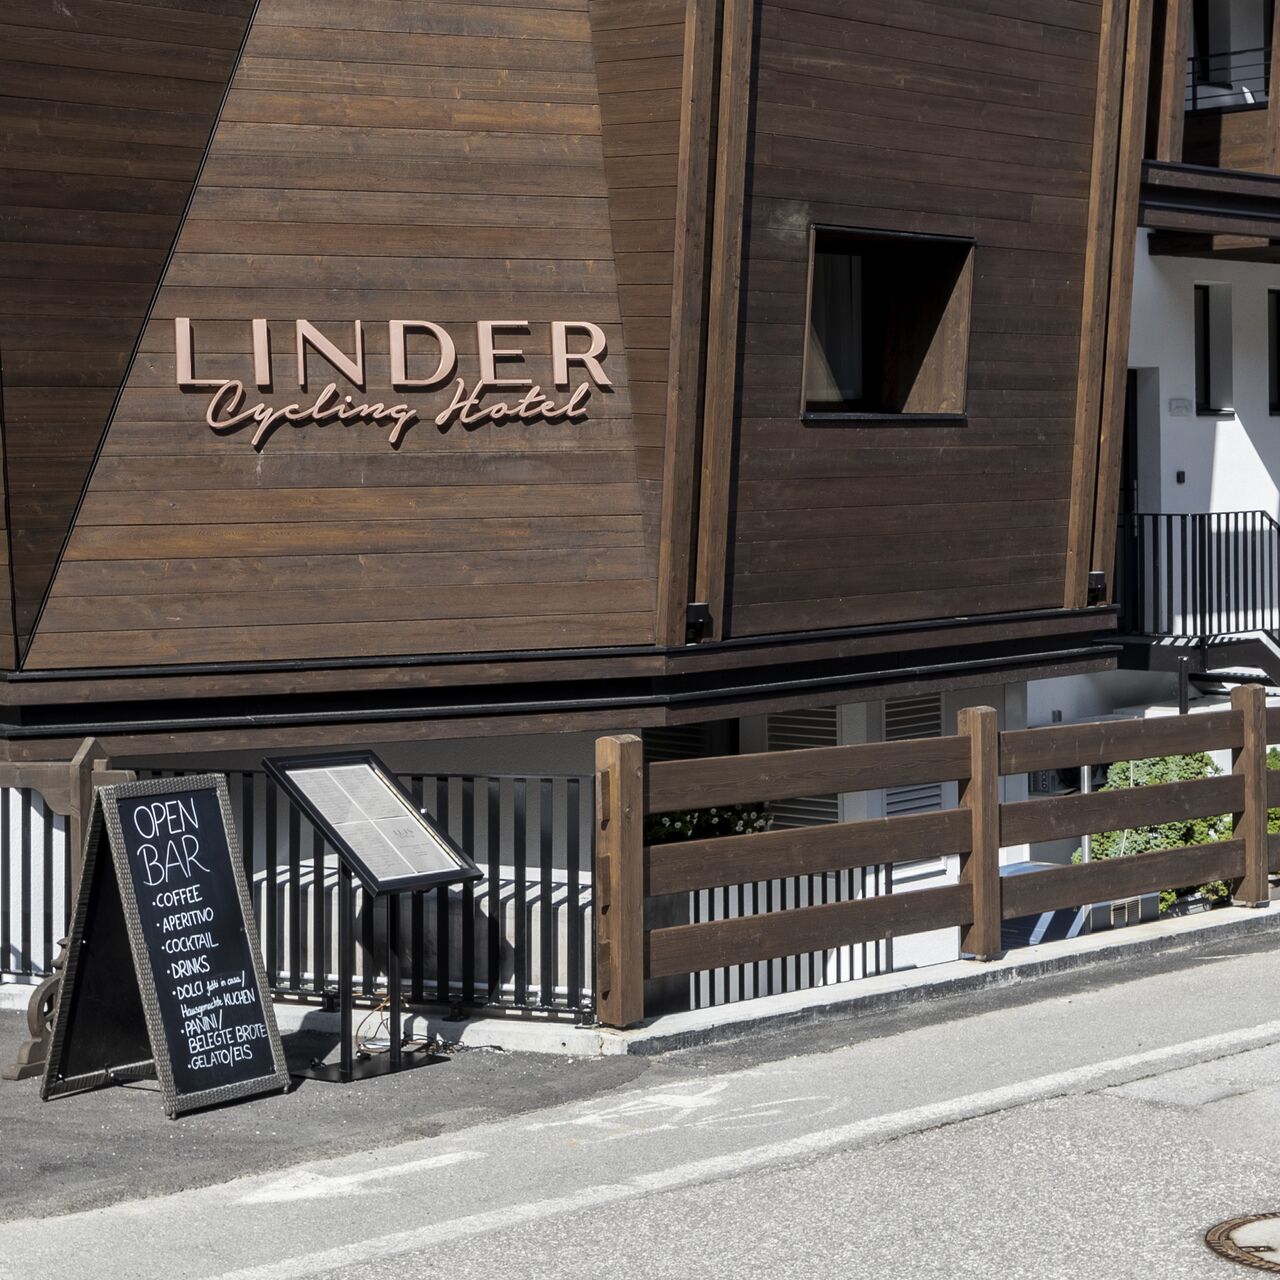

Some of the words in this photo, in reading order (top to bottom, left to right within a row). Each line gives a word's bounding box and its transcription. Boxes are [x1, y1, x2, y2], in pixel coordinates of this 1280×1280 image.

[174, 317, 613, 386] LINDER
[206, 380, 417, 445] Cycling
[434, 377, 588, 426] Hotel
[133, 797, 199, 839] OPEN
[136, 834, 211, 886] BAR
[224, 988, 256, 1007] KUCHEN
[188, 1027, 234, 1054] BELEGTE
[235, 1022, 268, 1043] BROTE
